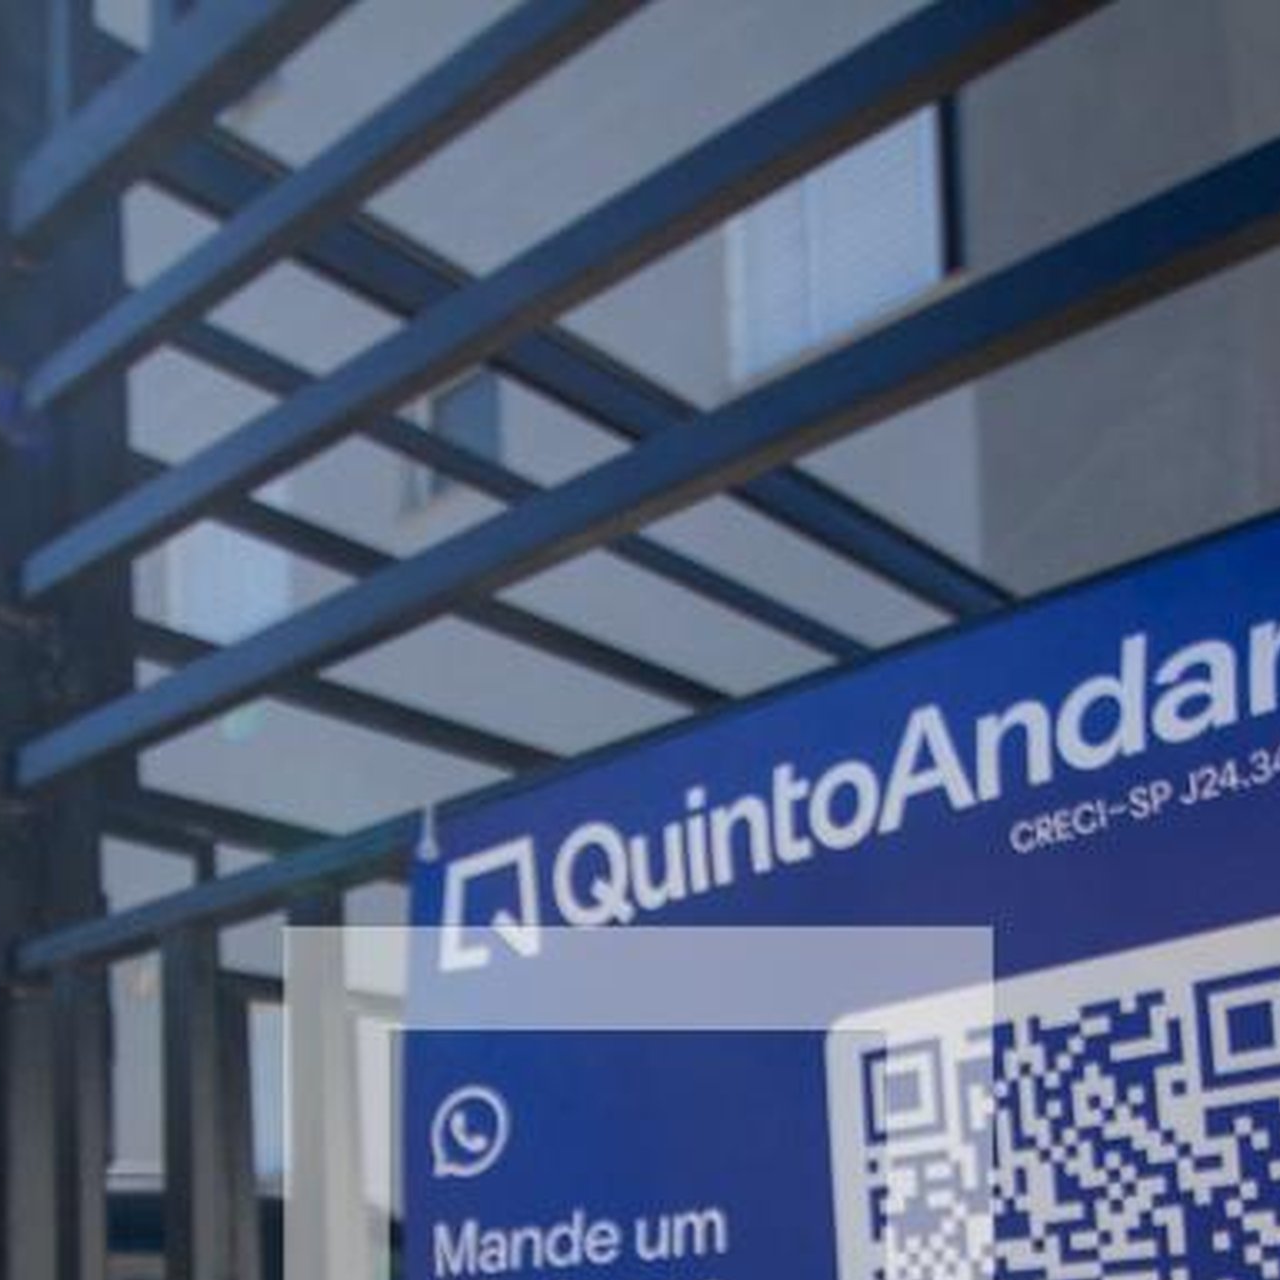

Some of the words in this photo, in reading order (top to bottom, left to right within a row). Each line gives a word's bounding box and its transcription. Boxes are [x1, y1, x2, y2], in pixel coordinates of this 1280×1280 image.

[1009, 779, 1173, 853] CRECI-SP
[432, 1208, 621, 1278] Mande
[634, 1206, 728, 1261] um
